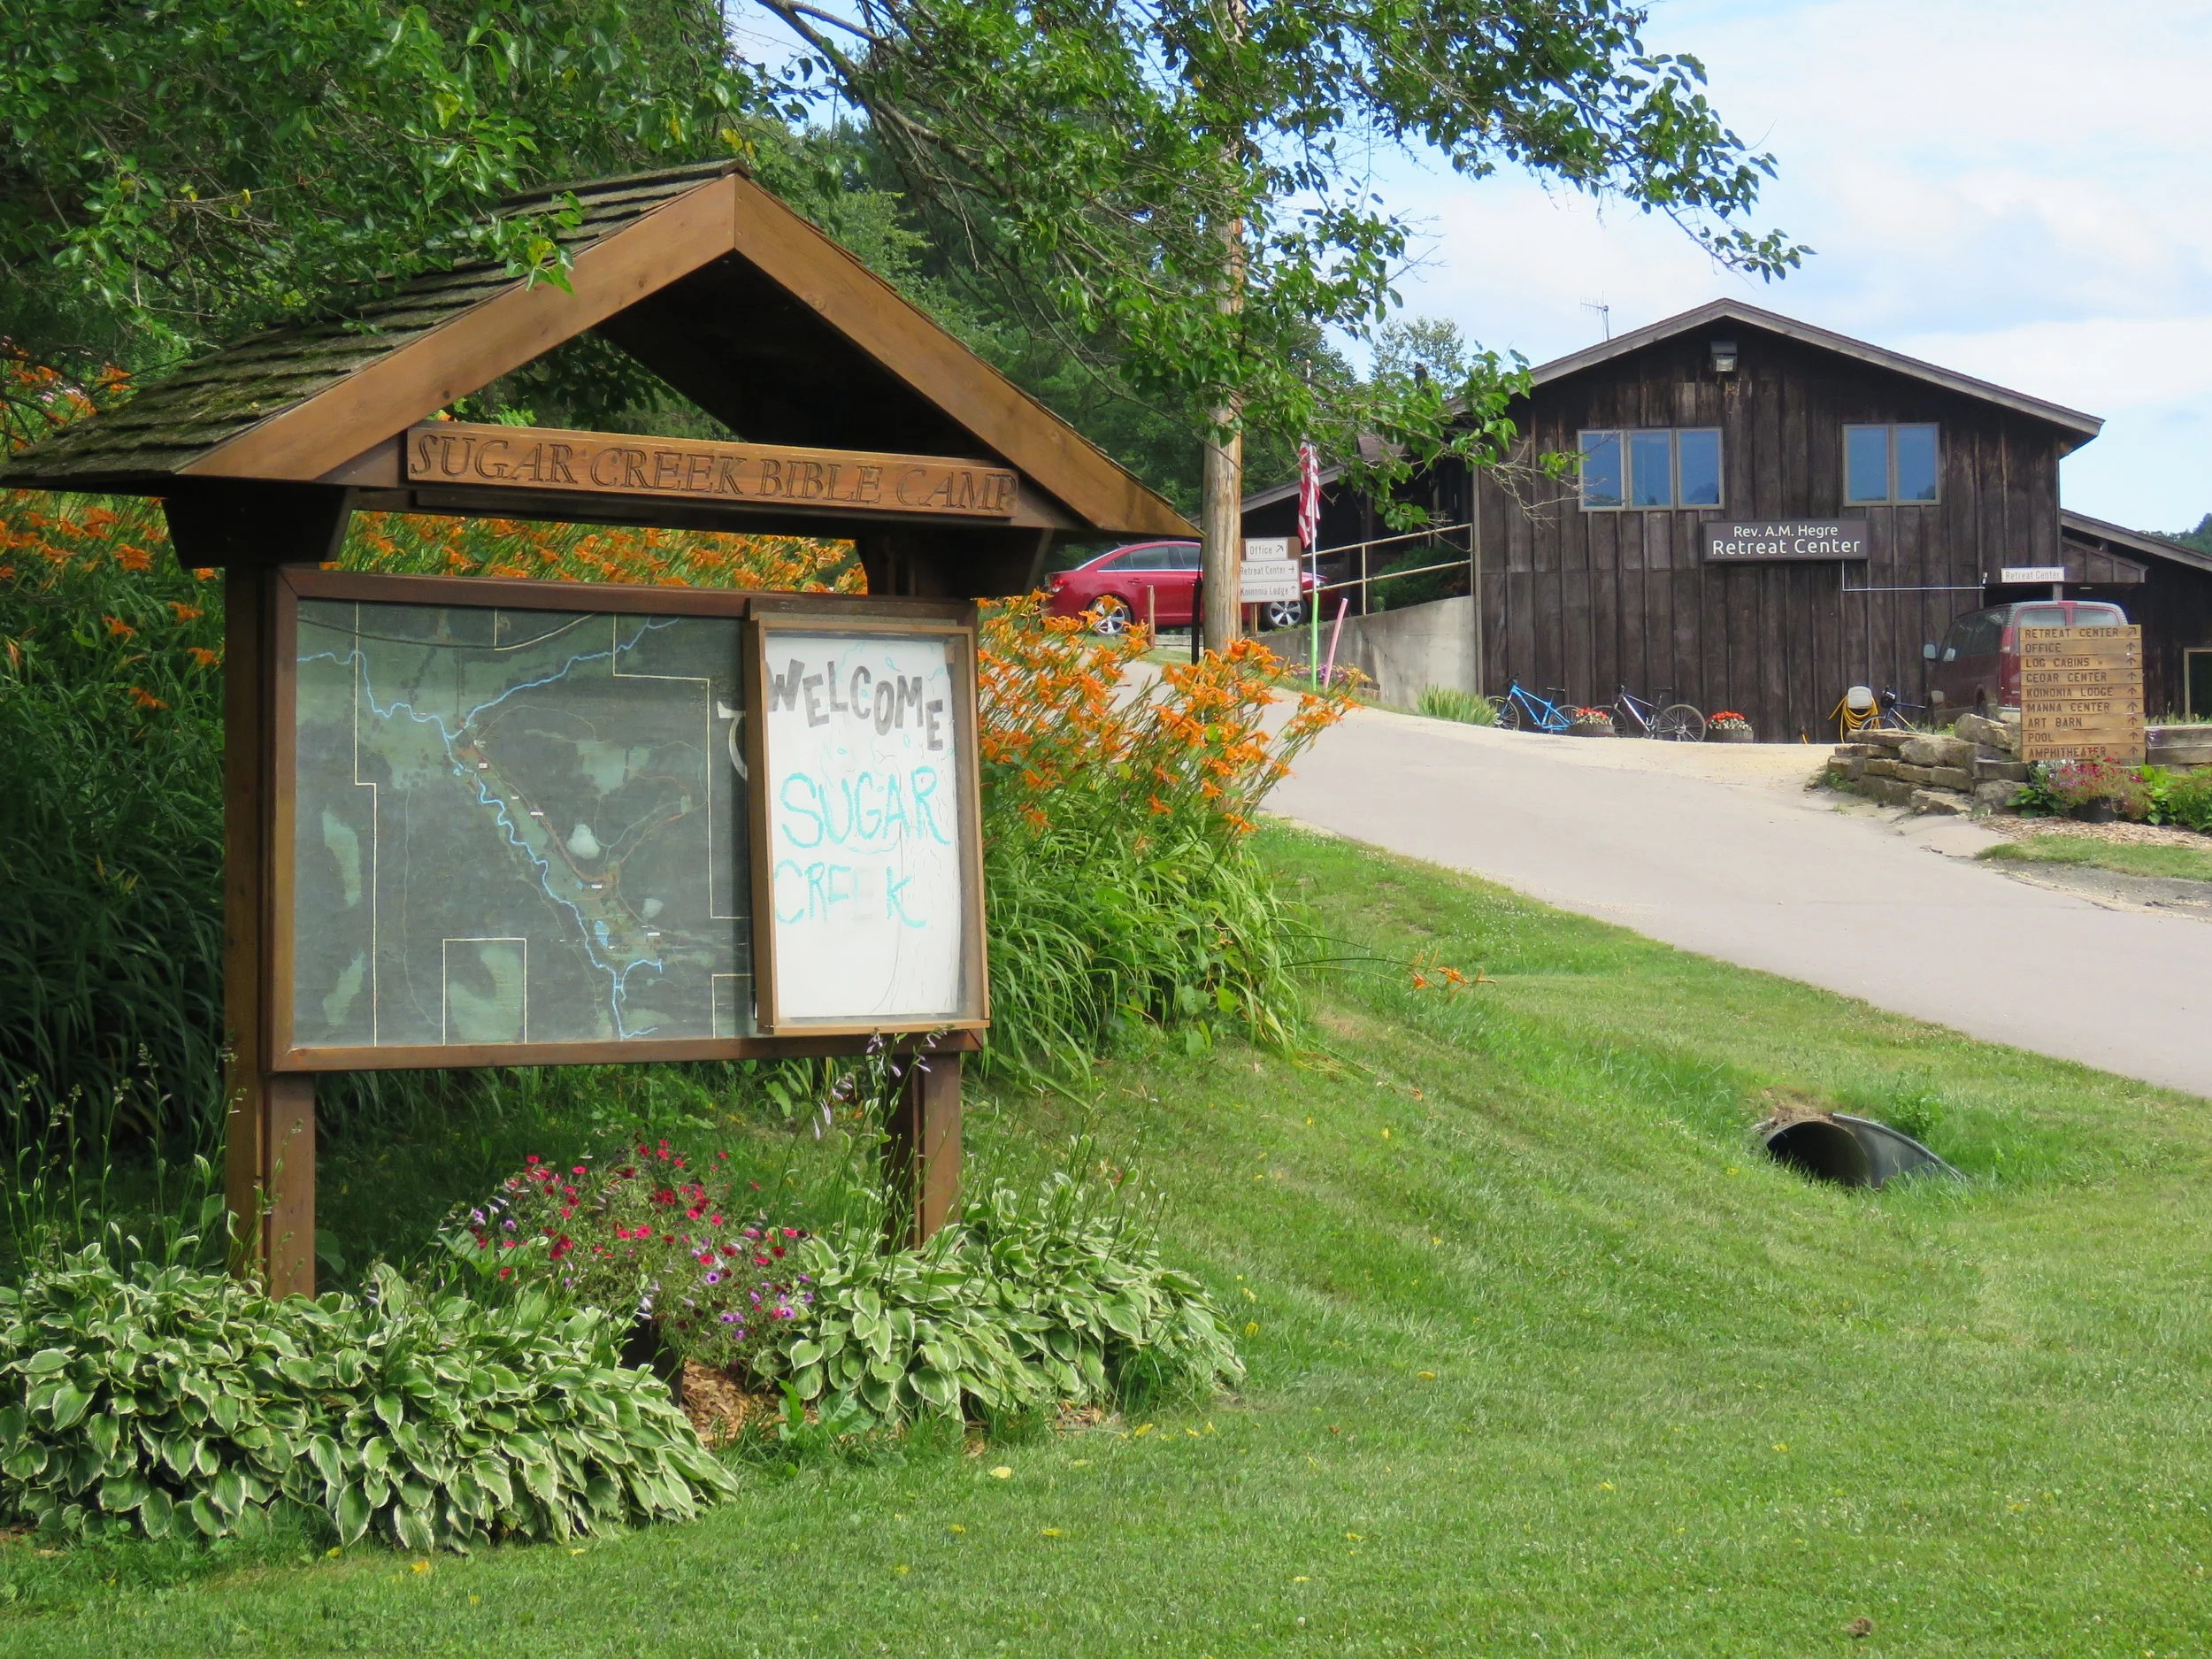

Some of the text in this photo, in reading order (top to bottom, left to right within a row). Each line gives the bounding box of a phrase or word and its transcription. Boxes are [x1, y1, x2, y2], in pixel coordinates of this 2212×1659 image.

[411, 434, 1017, 512] SUGAR CREEK BIBLE CAMP
[1733, 525, 1839, 539] Rev. A.M. Hegre
[1249, 545, 1273, 555] Office
[1712, 538, 1861, 555] Retreat Center
[1265, 565, 1286, 574] Center
[2005, 570, 2062, 580] Retreat Center
[1270, 586, 1289, 597] Lodge
[2024, 627, 2118, 639] RETREAT CENTER
[2024, 642, 2062, 653] OFFICE
[2026, 657, 2090, 668] LOG CABINS
[2026, 672, 2107, 683] CEDAR CENTER
[2026, 687, 2072, 698] KOINONIA
[2080, 687, 2114, 697] LODGE
[767, 657, 944, 751] WELCOME
[2027, 702, 2110, 713] MANNA CENTER
[2028, 717, 2082, 728] ART BARN
[2028, 733, 2054, 742] POOL
[780, 765, 950, 849] SUGAR
